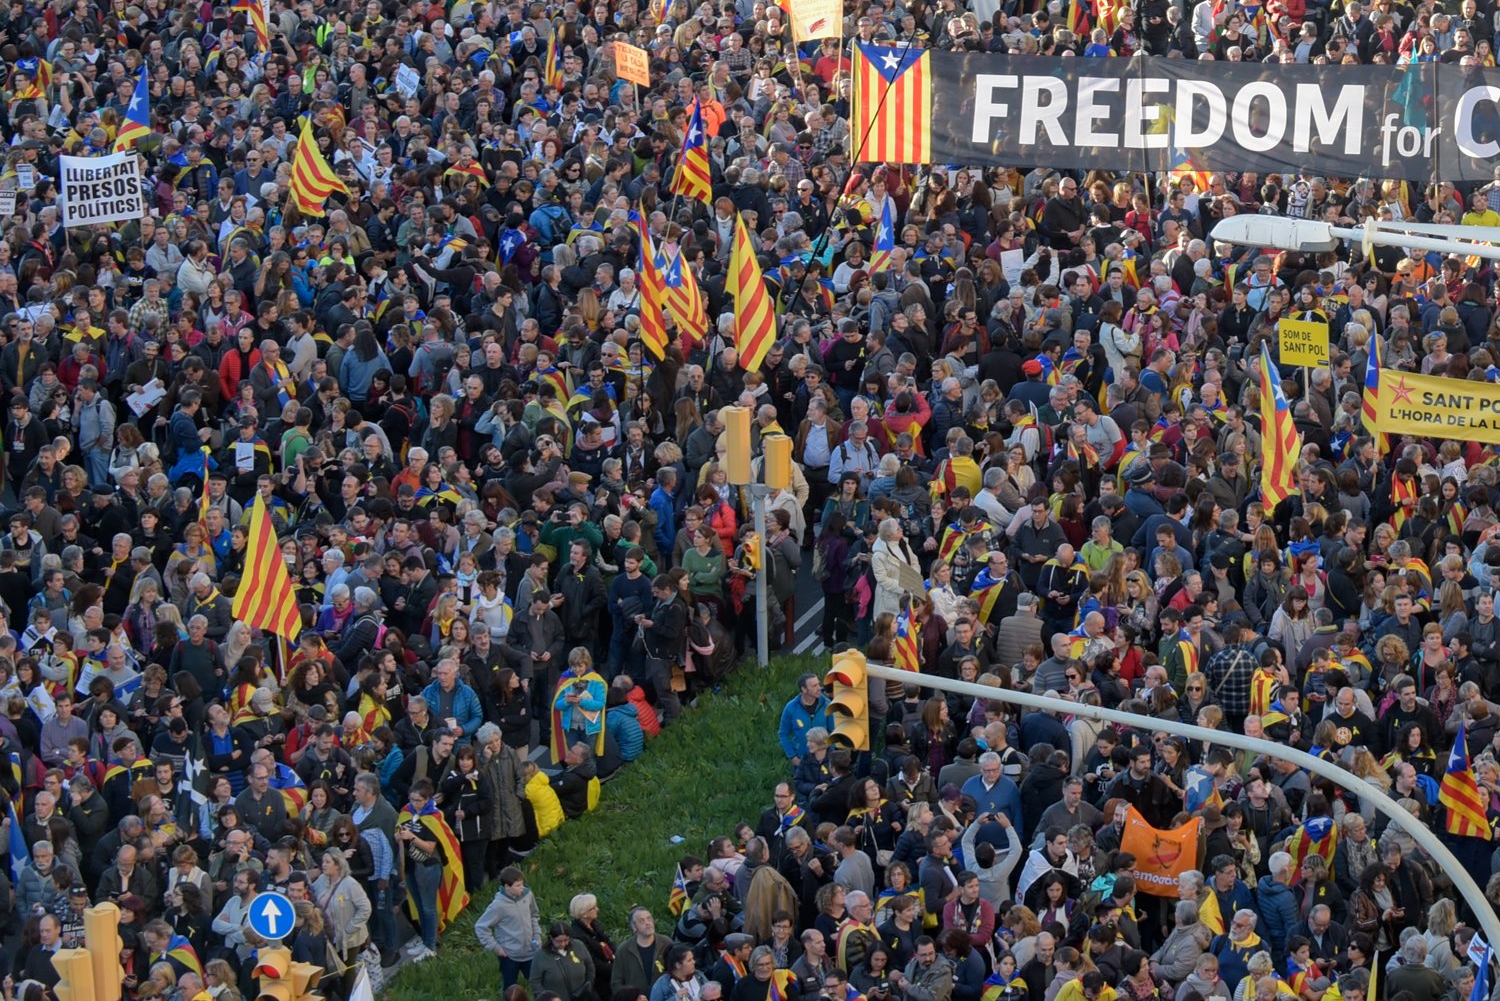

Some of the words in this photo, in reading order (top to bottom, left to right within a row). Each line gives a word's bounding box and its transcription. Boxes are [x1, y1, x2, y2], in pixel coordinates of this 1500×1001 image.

[971, 74, 1365, 154] FREEDOM
[1381, 113, 1441, 166] for
[66, 161, 136, 182] LLIBERTAT
[67, 177, 139, 202] PRESOS
[68, 197, 141, 220] POLÍTICS!
[1283, 329, 1300, 339] SOM
[1302, 332, 1312, 341] DE
[1283, 341, 1306, 353] SANT
[1308, 344, 1325, 356] POL
[1422, 391, 1474, 410] SANT
[1390, 408, 1442, 424] L'HORA
[1447, 415, 1465, 426] DE
[1470, 418, 1488, 429] LA
